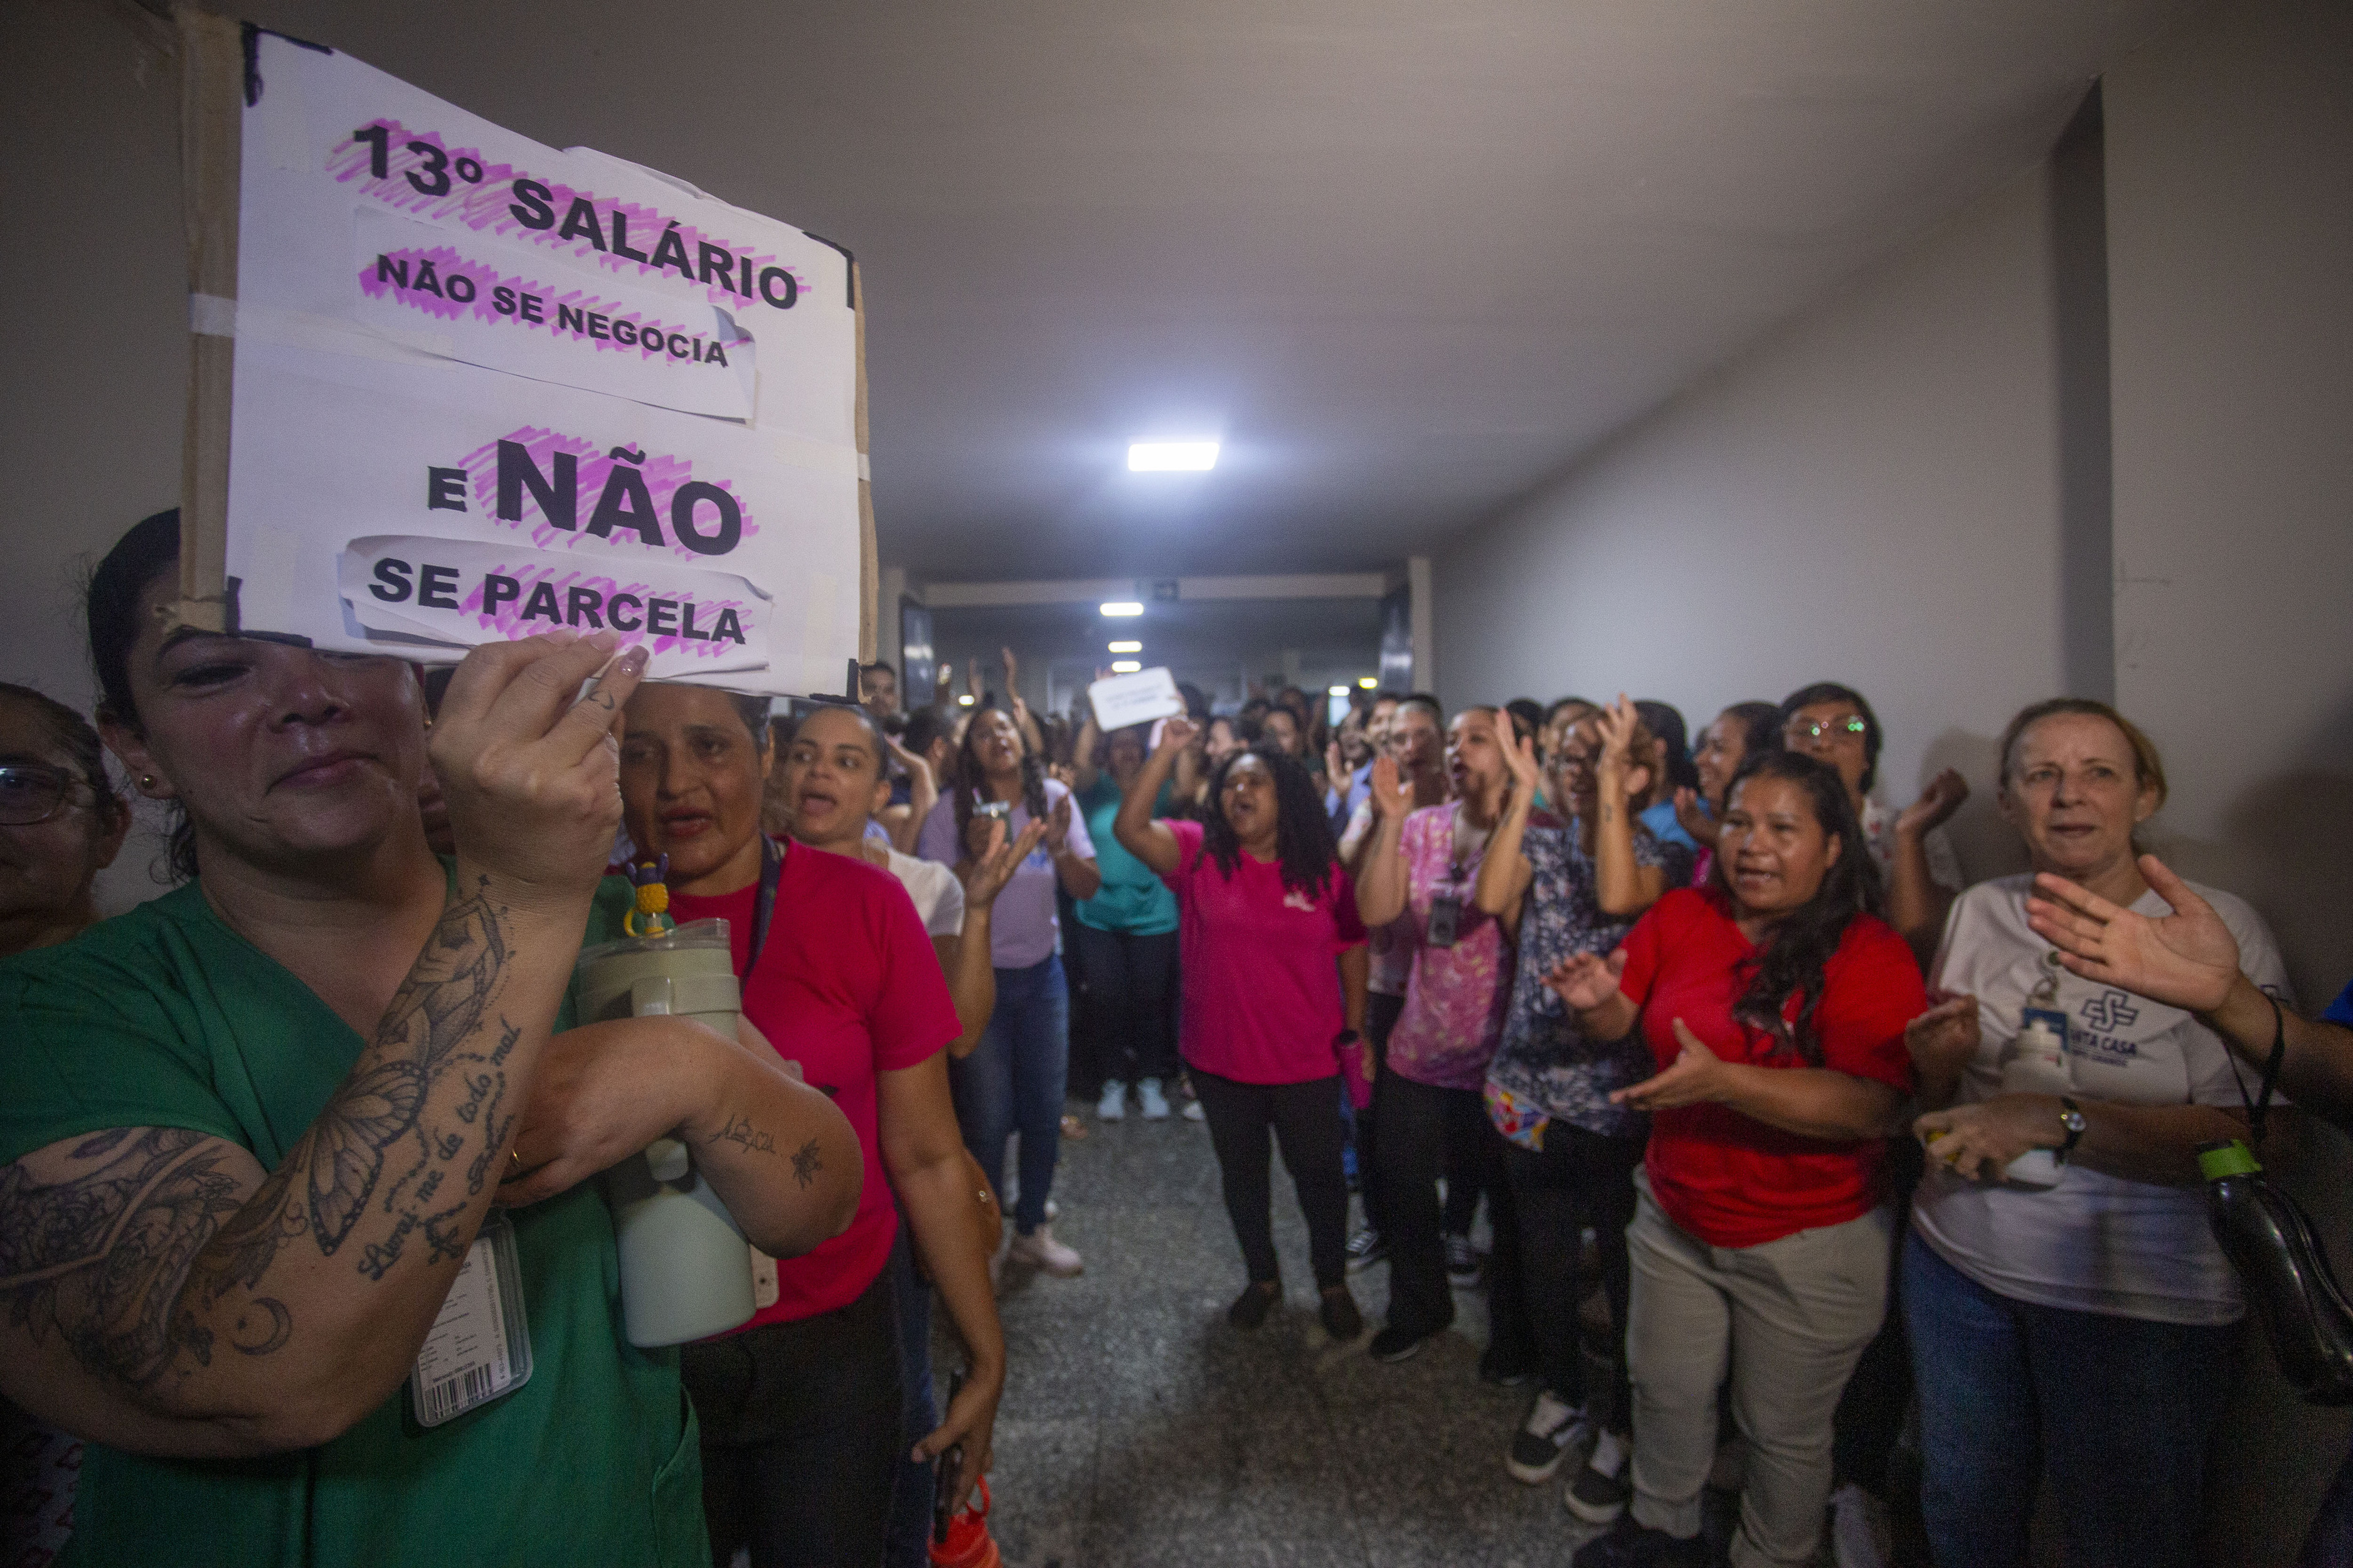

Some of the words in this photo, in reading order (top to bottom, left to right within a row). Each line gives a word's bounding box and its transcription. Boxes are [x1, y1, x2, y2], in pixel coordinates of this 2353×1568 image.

[509, 177, 798, 309] SALÁRIO
[376, 253, 476, 304] NÃO
[492, 286, 544, 323] SE
[558, 304, 728, 366] NEGOCIA
[428, 466, 467, 512] E
[496, 439, 740, 555] NÃO
[368, 557, 459, 609] SE
[483, 574, 745, 644] PARCELA
[435, 1128, 464, 1161] de
[457, 1073, 491, 1123] todo
[491, 1015, 521, 1066] mal
[2101, 1037, 2137, 1054] CASA
